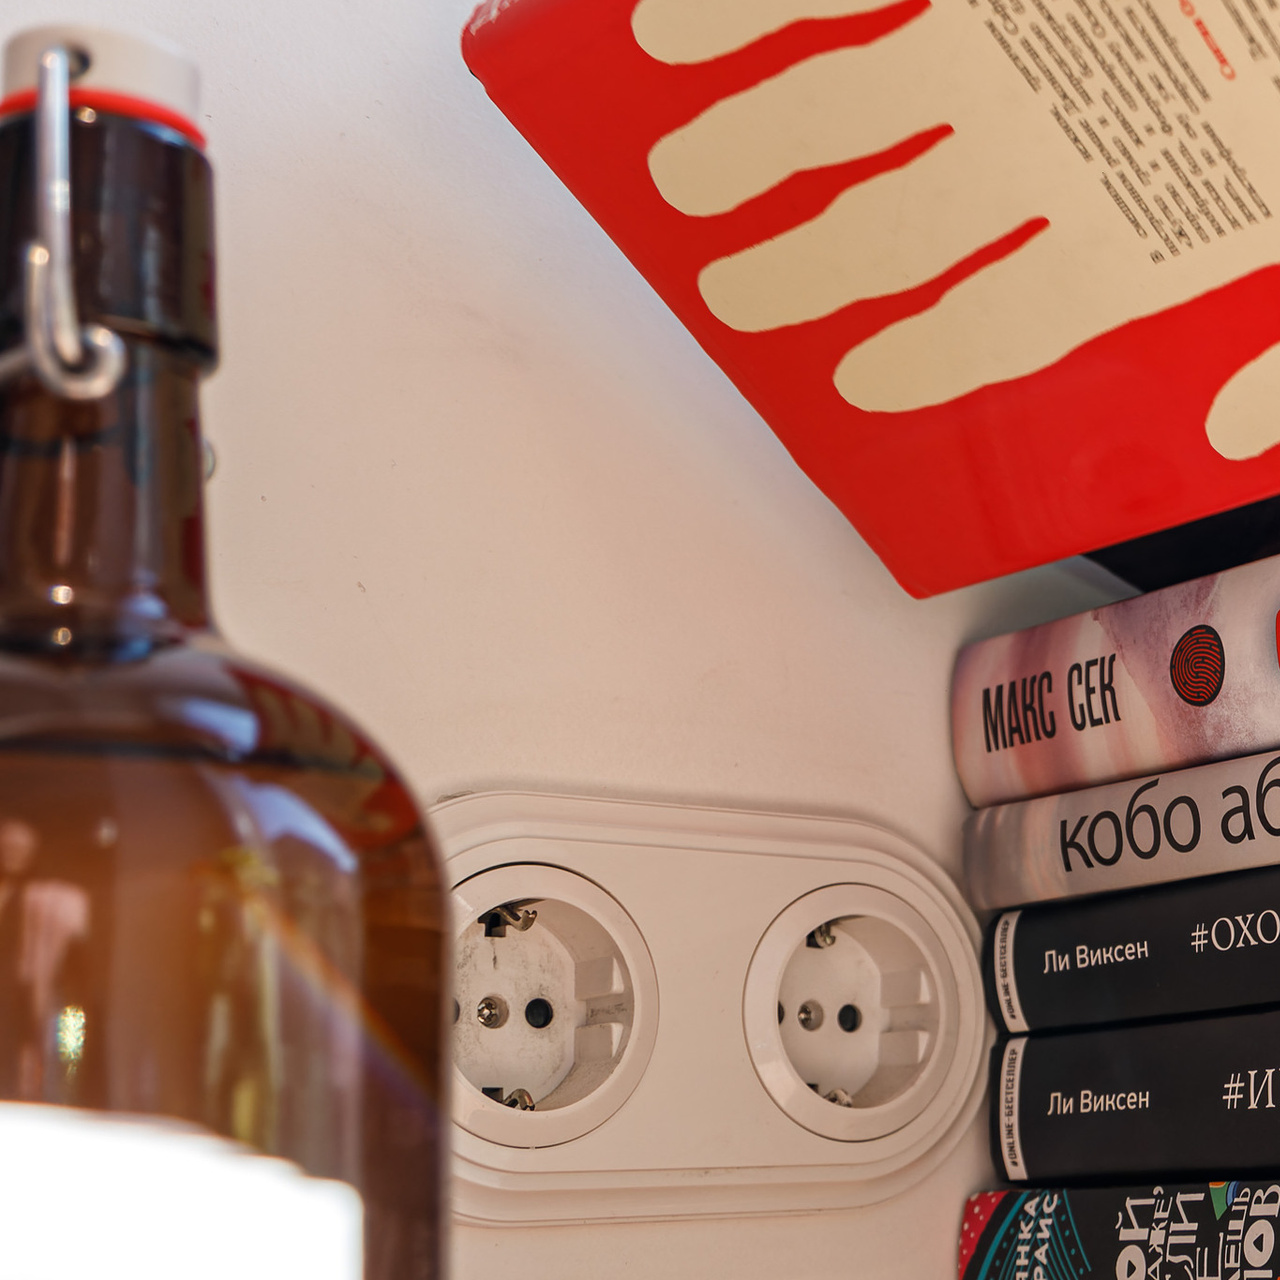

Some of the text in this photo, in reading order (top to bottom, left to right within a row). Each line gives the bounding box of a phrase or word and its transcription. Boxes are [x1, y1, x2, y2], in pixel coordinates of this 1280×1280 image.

[982, 653, 1121, 754] МАКС СЕК
[1059, 778, 1202, 873] кобо
[1042, 936, 1150, 975] Ли Виксен
[1046, 1086, 1150, 1115] Ли Виксен
